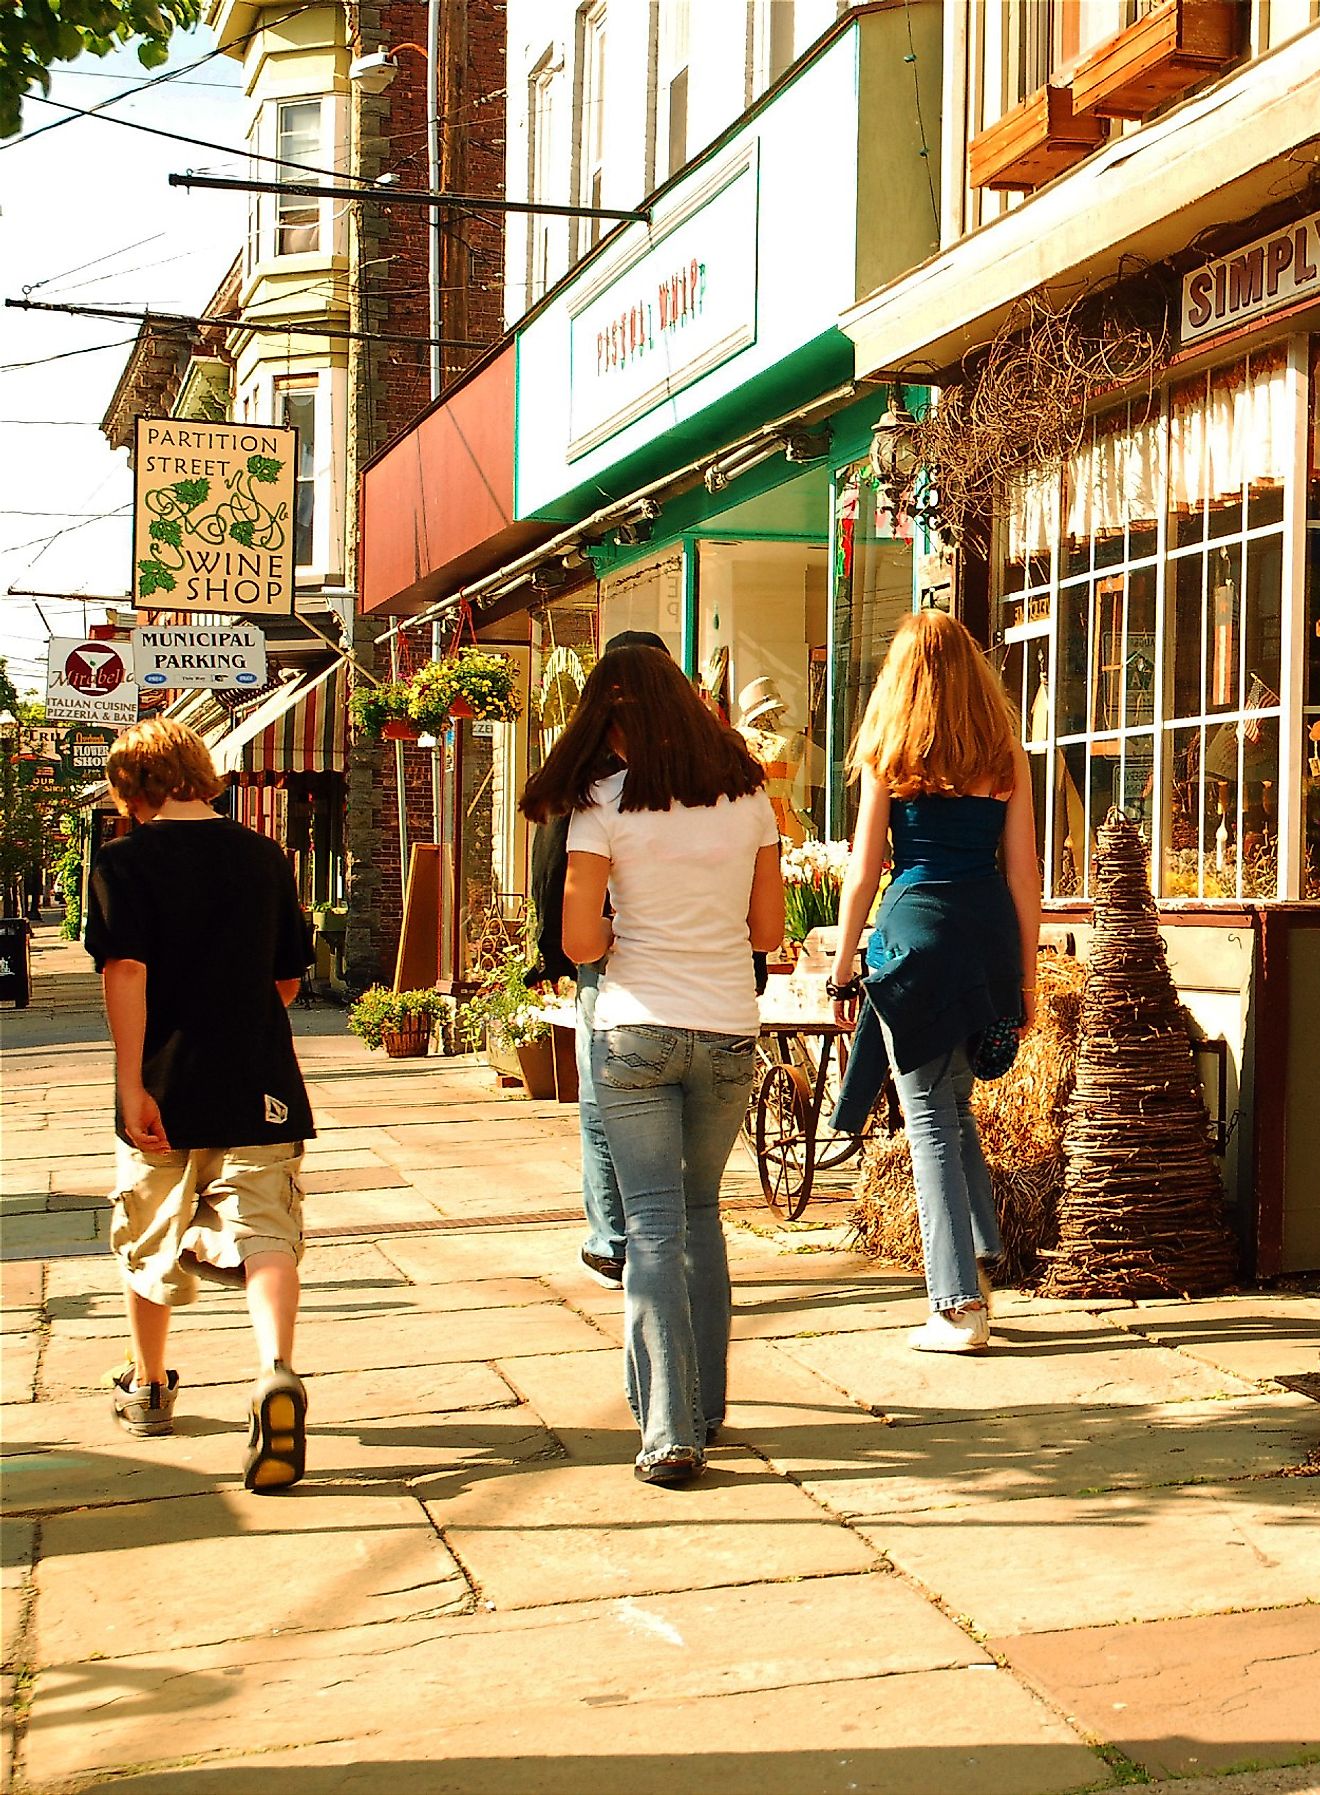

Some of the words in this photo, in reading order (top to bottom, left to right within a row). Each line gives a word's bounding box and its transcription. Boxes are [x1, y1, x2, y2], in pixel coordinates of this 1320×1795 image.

[147, 428, 277, 454] PARTITION
[146, 456, 231, 477] STREET
[186, 550, 283, 579] WINE
[186, 577, 283, 605] SHOP
[142, 632, 256, 647] MUNICIPAL
[155, 654, 247, 669] PARKING
[47, 698, 91, 709] ITALIAN
[94, 701, 137, 712] CUISINE
[47, 709, 98, 720] PIZZERIA
[102, 712, 110, 721] &
[114, 712, 135, 722] BAR
[73, 745, 109, 757] FLOWER
